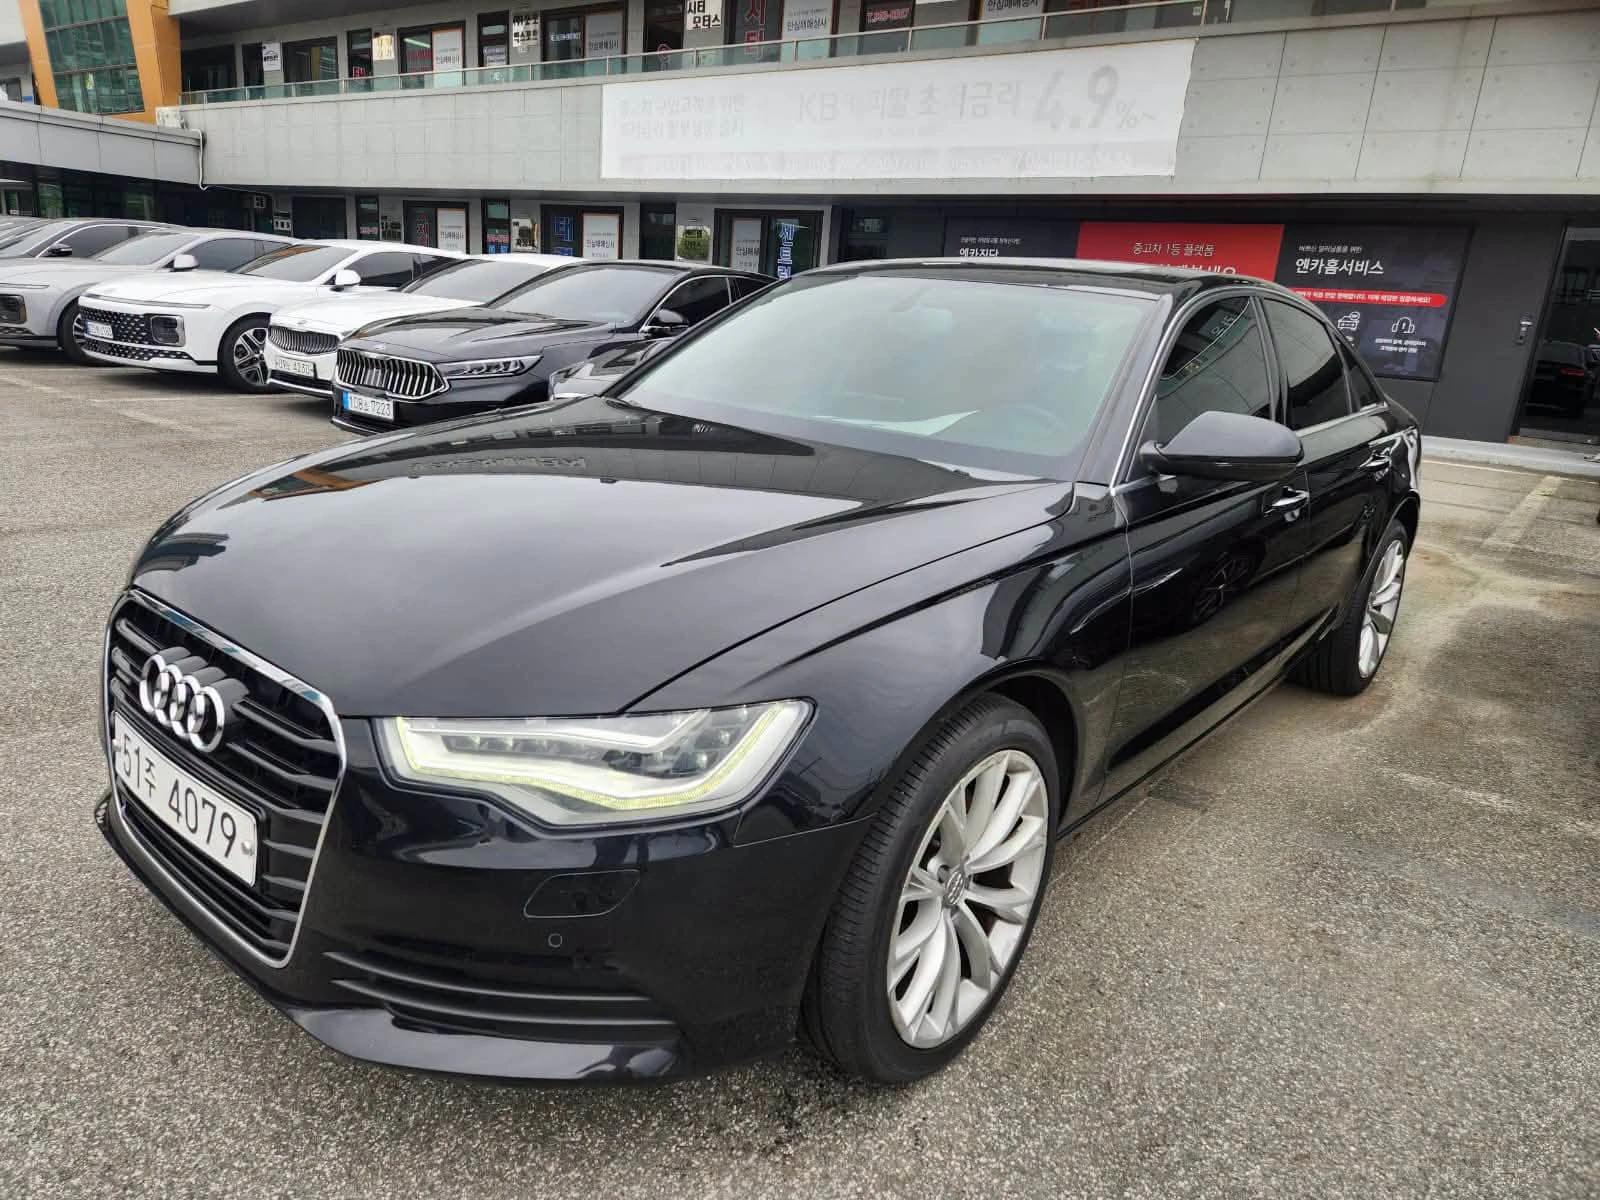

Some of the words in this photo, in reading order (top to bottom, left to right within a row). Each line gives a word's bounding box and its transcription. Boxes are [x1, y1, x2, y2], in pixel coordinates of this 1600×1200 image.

[692, 14, 720, 29] 모터스
[1133, 242, 1162, 255] 중고차
[1166, 243, 1181, 256] 1등
[1184, 243, 1216, 257] 플랫폼
[1295, 257, 1385, 276] 엔카홈서비스
[371, 400, 392, 417] 7223
[123, 732, 157, 798] 51주
[168, 779, 238, 859] 4079
